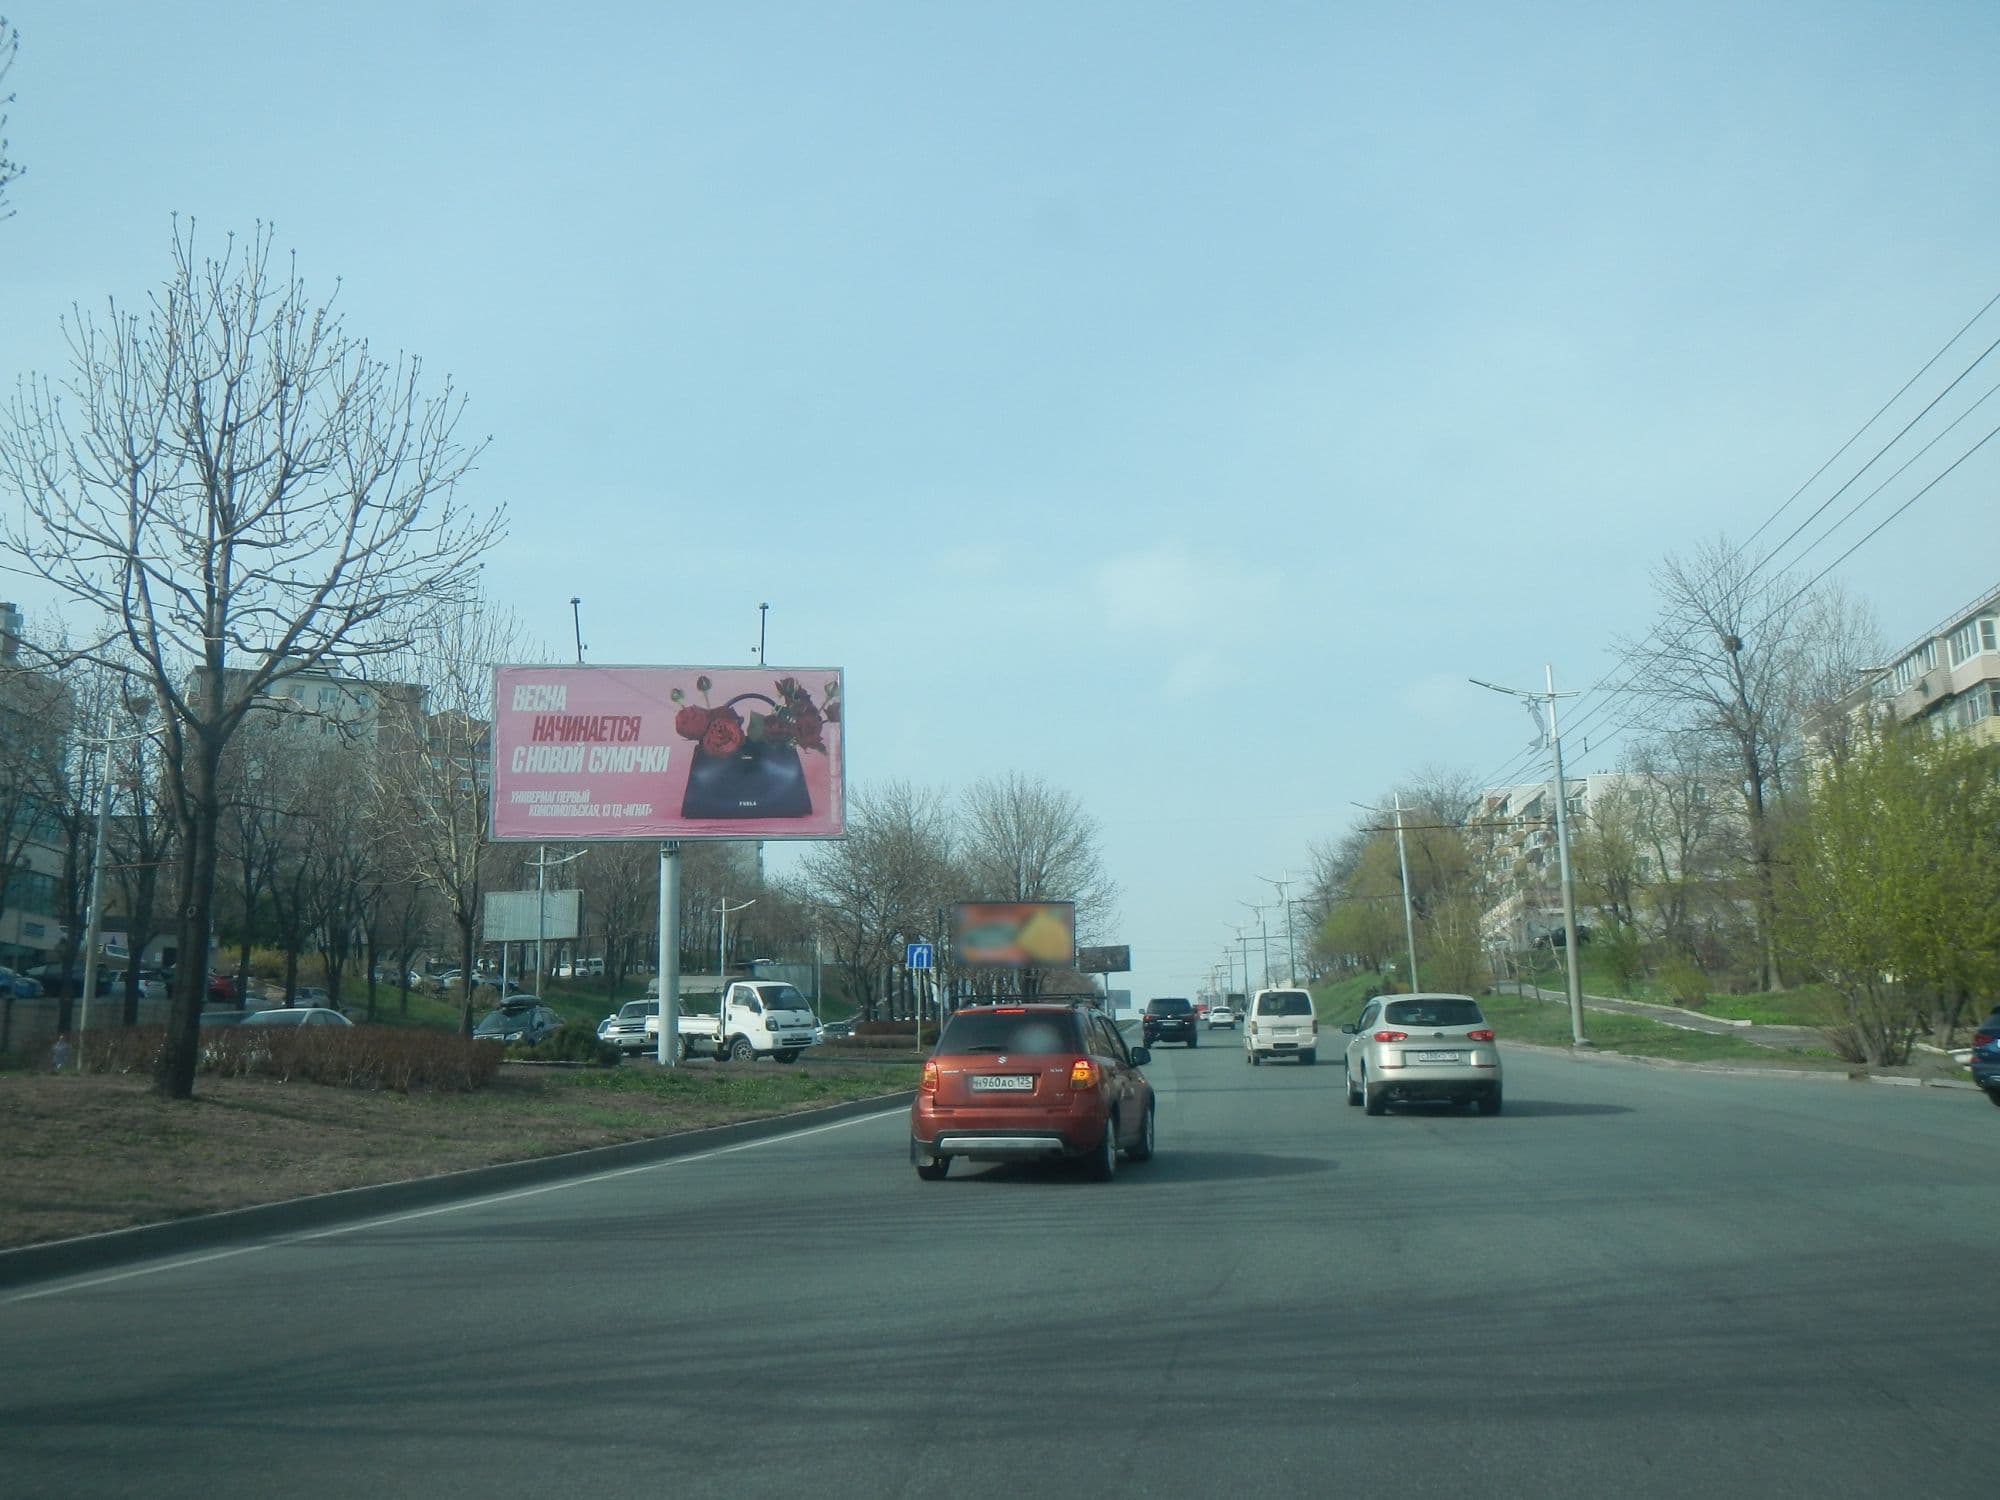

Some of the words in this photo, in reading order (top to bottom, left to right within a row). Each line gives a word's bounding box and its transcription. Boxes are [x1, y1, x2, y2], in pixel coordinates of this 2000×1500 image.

[512, 685, 567, 711] ВЕСНА
[532, 715, 642, 742] НАЧИНАЕТСЯ
[511, 746, 526, 773] С
[526, 742, 585, 773] НОВОЙ
[588, 746, 670, 773] СУМОЧКИ
[556, 789, 590, 803] ПЕРВЫЙ
